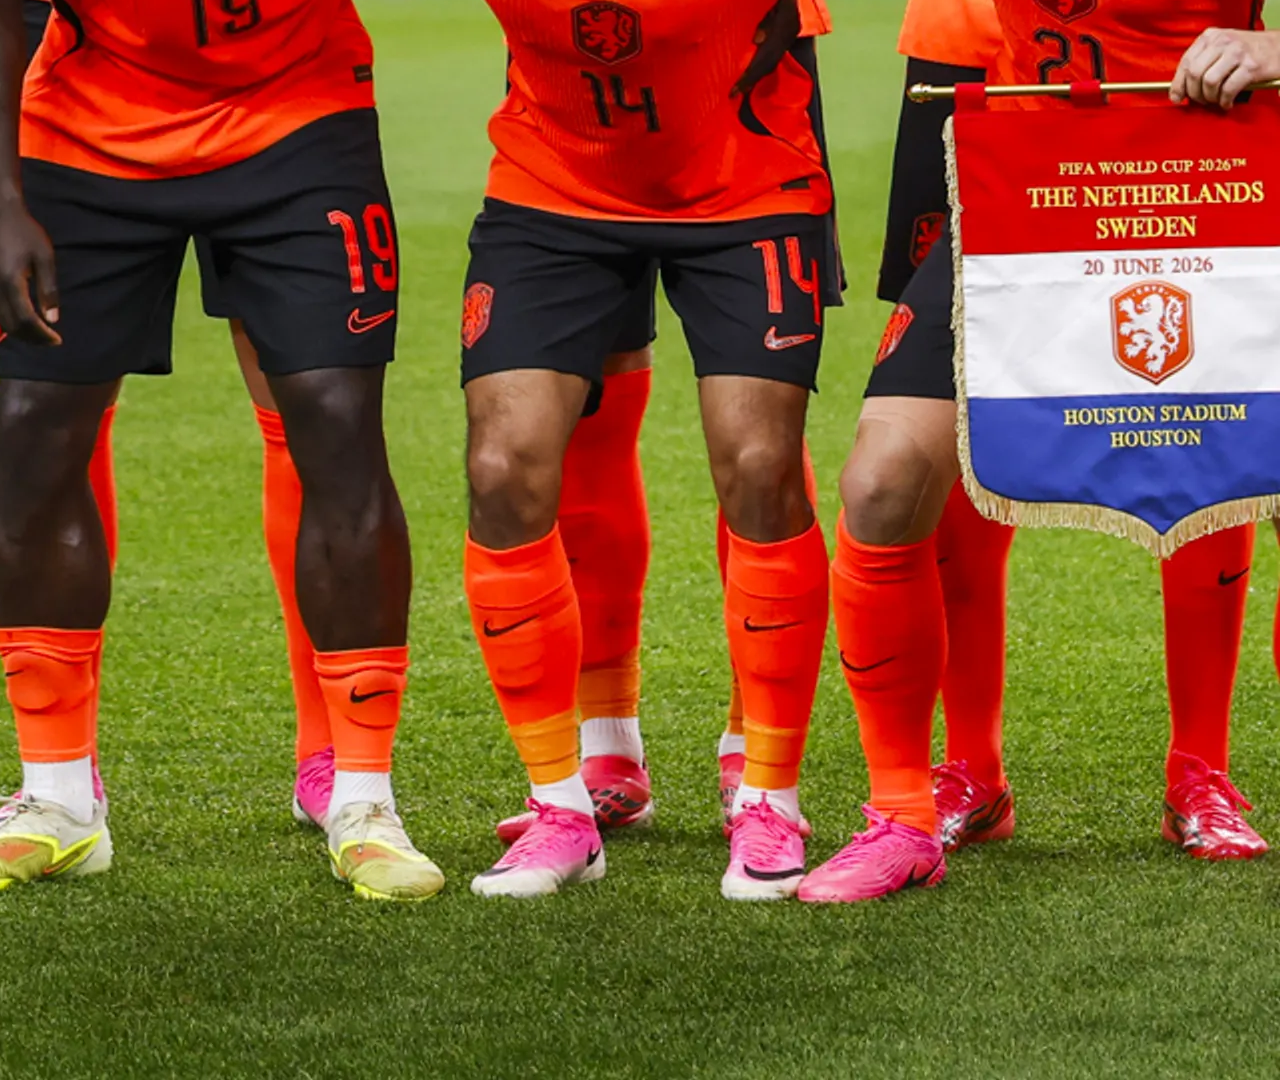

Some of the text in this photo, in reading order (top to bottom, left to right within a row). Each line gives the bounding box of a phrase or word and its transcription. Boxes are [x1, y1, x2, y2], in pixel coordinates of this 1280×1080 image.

[1035, 28, 1108, 105] 21
[580, 70, 661, 133] 14
[1058, 162, 1095, 176] FIFA
[1098, 160, 1158, 175] WORLD
[1161, 159, 1194, 173] CUP
[1026, 180, 1265, 208] THE NETHERLANDS
[1096, 215, 1197, 240] SWEDEN
[326, 203, 398, 293] 19
[1083, 256, 1214, 276] 20 JUNE 2026
[751, 235, 822, 326] 14
[1063, 404, 1247, 426] HOUSTON STADIUM
[1110, 429, 1202, 449] HOUSTON
